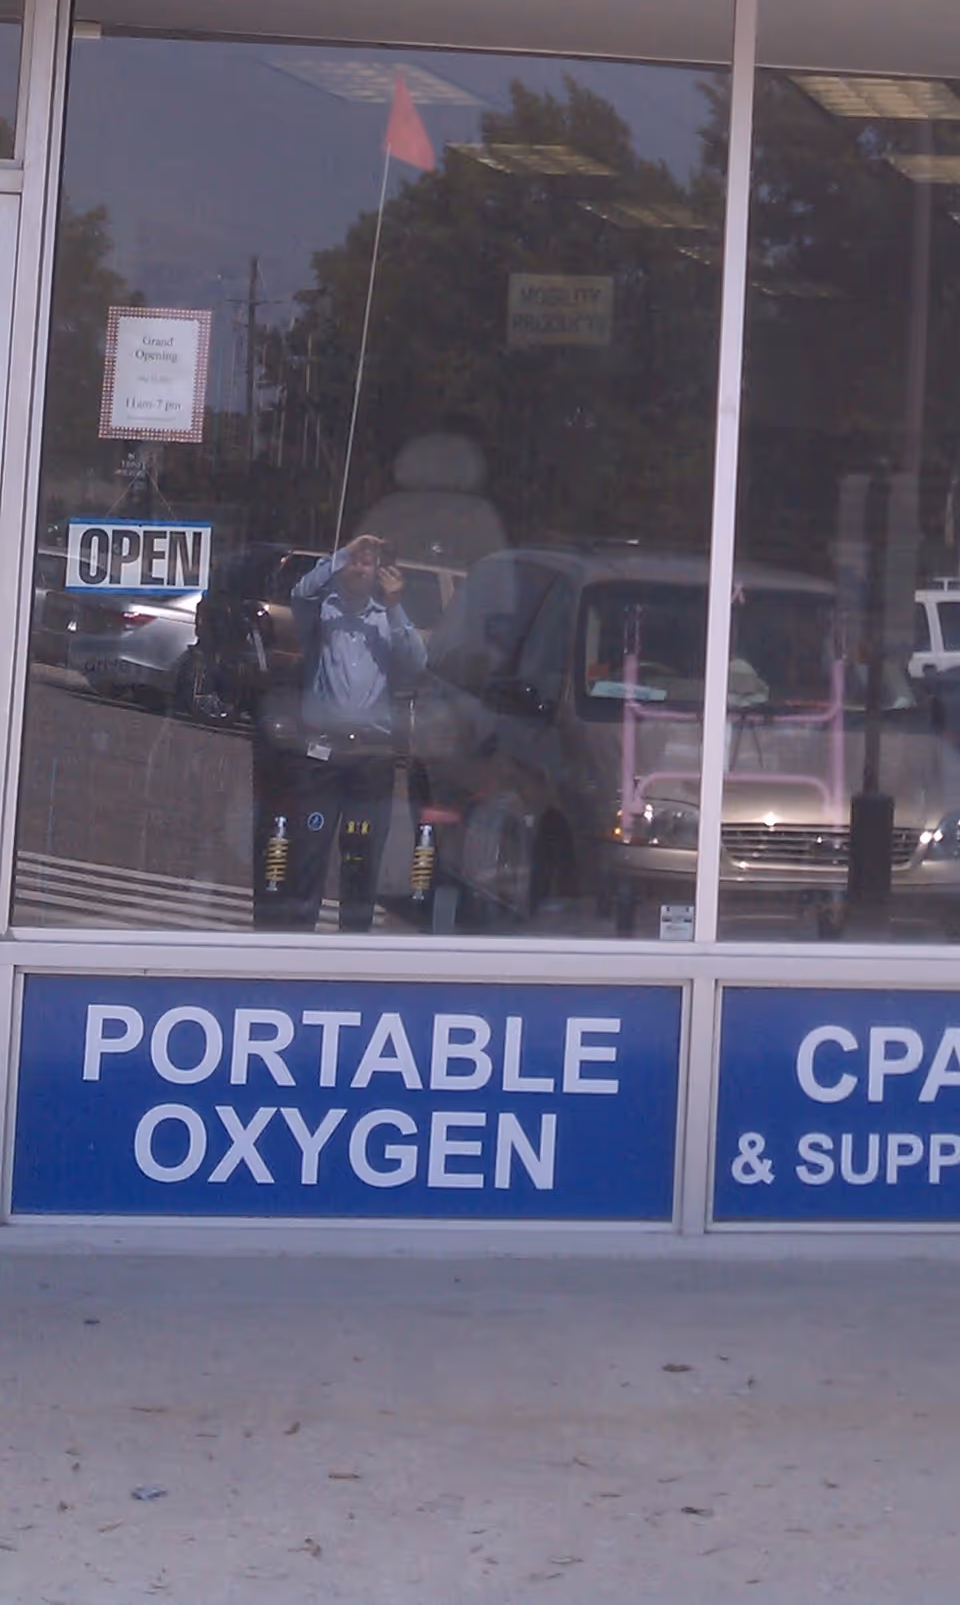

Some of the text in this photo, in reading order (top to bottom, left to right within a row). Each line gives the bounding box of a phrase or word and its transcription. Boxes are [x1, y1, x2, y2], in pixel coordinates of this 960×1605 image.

[134, 349, 178, 363] Opening
[142, 336, 174, 347] Grand
[78, 527, 202, 586] OPEN
[82, 1003, 621, 1094] PORTABLE
[133, 1103, 557, 1190] OXYGEN
[731, 1131, 775, 1185] &
